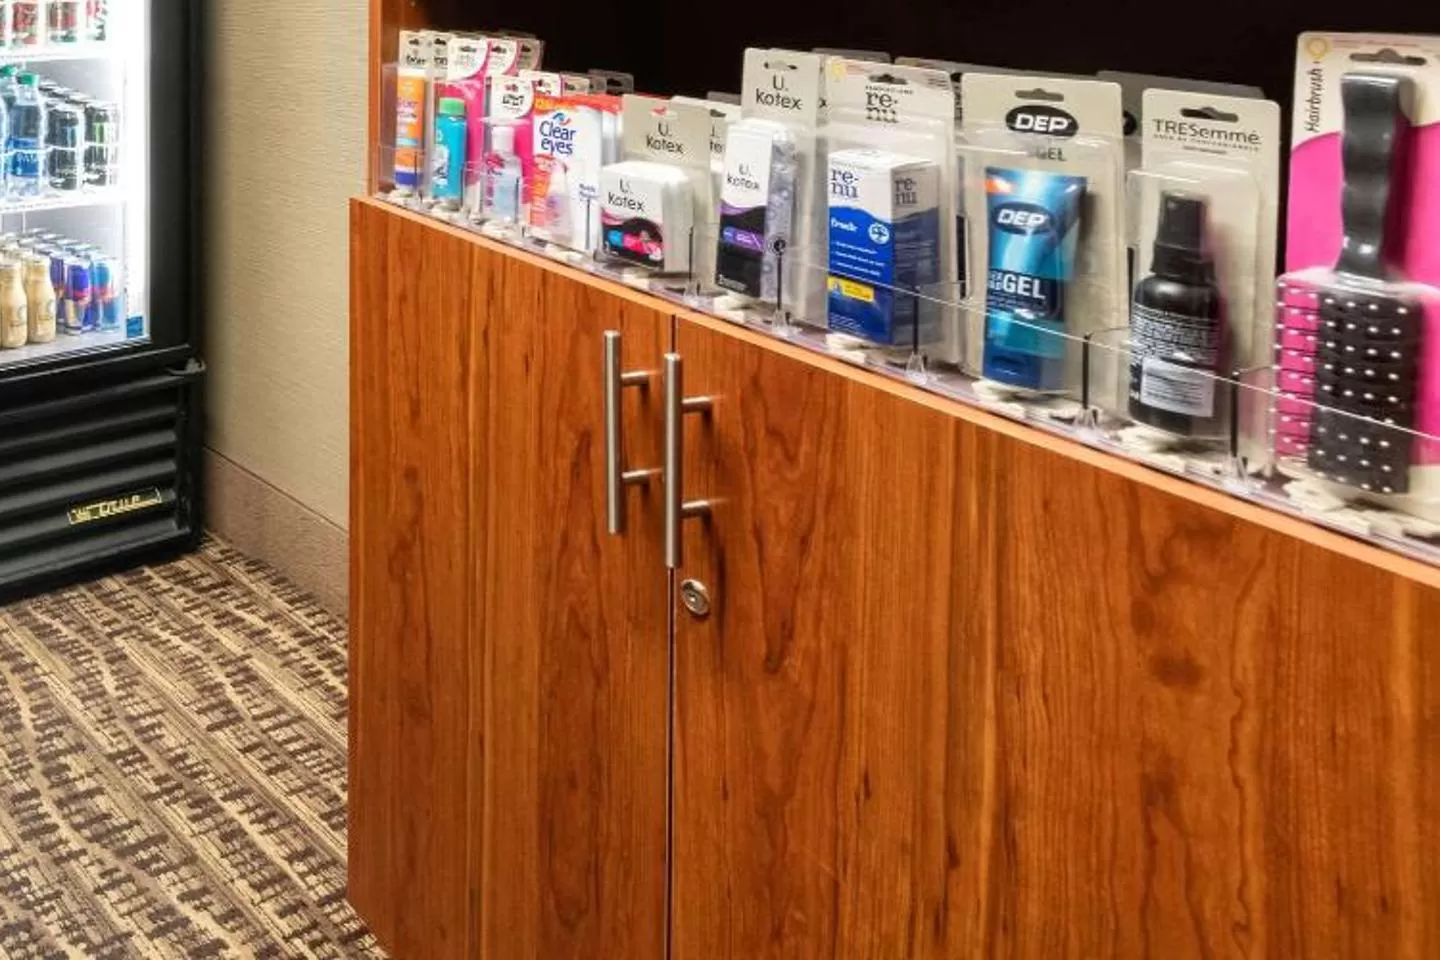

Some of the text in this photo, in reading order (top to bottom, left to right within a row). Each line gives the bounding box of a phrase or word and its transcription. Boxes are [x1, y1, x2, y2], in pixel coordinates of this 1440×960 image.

[1306, 61, 1323, 134] Hairbrush
[539, 120, 577, 142] Clear
[1014, 113, 1069, 133] DEP
[1152, 118, 1262, 145] TRESemmé
[540, 138, 574, 156] eyes
[1035, 146, 1067, 162] GEL
[997, 208, 1047, 227] DEP
[1003, 273, 1046, 299] GEL
